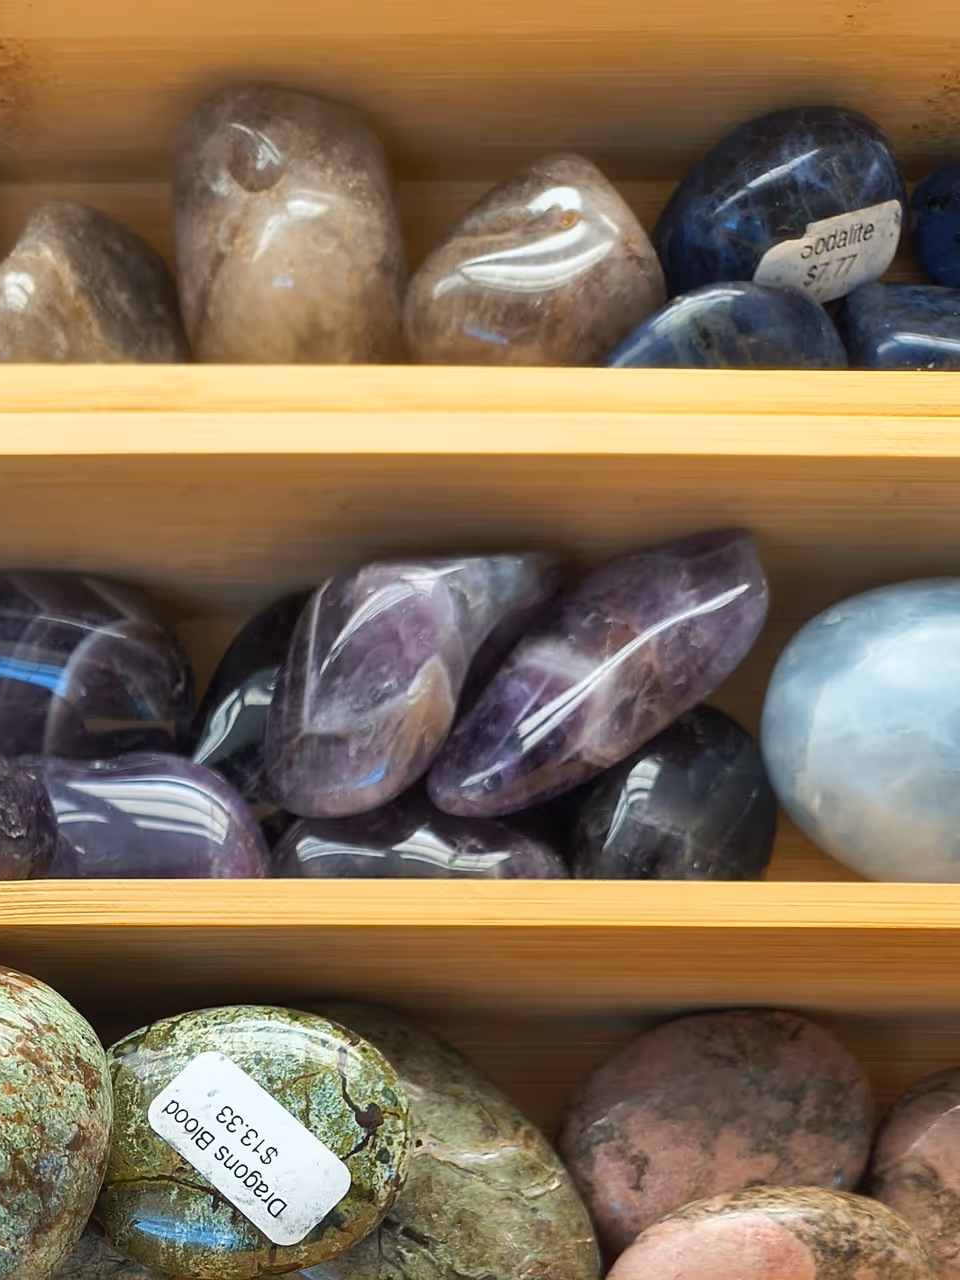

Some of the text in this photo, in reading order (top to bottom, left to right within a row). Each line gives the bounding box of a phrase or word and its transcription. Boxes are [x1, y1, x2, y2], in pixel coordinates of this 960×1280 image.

[800, 223, 876, 260] Sodalite
[803, 253, 859, 289] $7.77
[161, 1099, 288, 1219] Dragons Blood
[215, 1105, 279, 1165] $13.33
